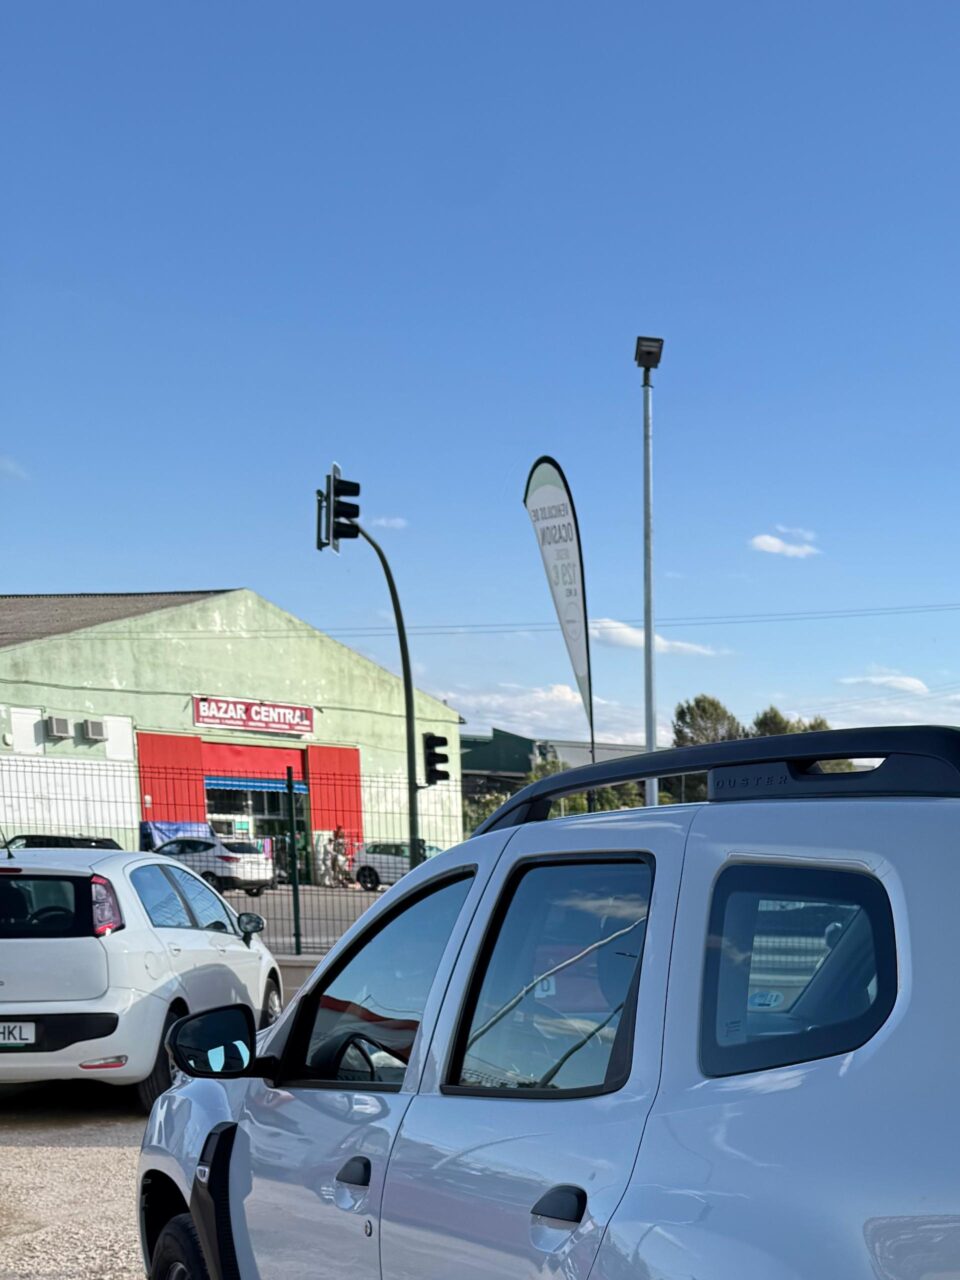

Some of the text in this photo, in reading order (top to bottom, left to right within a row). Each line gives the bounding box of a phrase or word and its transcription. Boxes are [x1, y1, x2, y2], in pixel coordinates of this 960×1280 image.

[199, 701, 246, 720] BAZAR
[251, 705, 310, 726] CENTRAL
[714, 775, 789, 790] DUSTER
